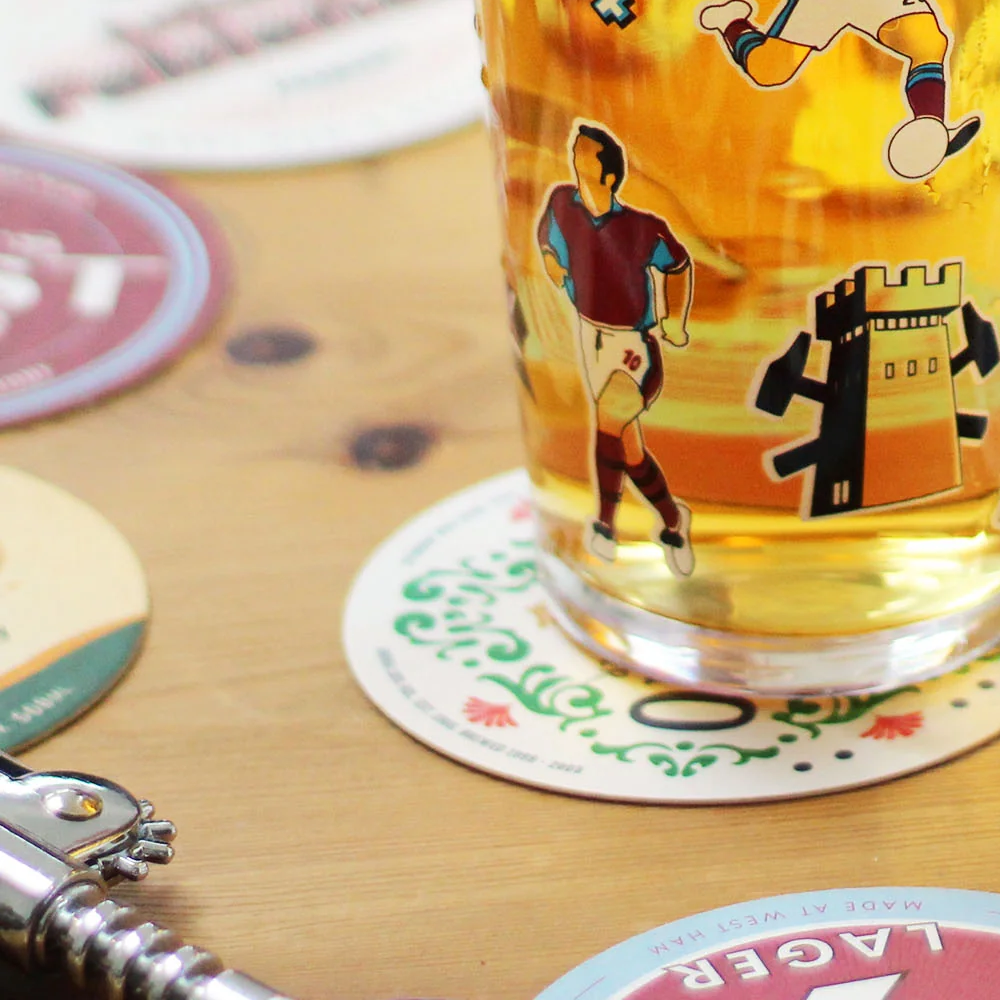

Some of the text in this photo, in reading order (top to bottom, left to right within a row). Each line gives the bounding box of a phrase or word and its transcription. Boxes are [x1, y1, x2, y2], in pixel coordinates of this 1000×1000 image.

[622, 349, 642, 371] 10
[648, 899, 923, 956] MADE AT WEST HAM
[666, 921, 945, 991] LAGER
